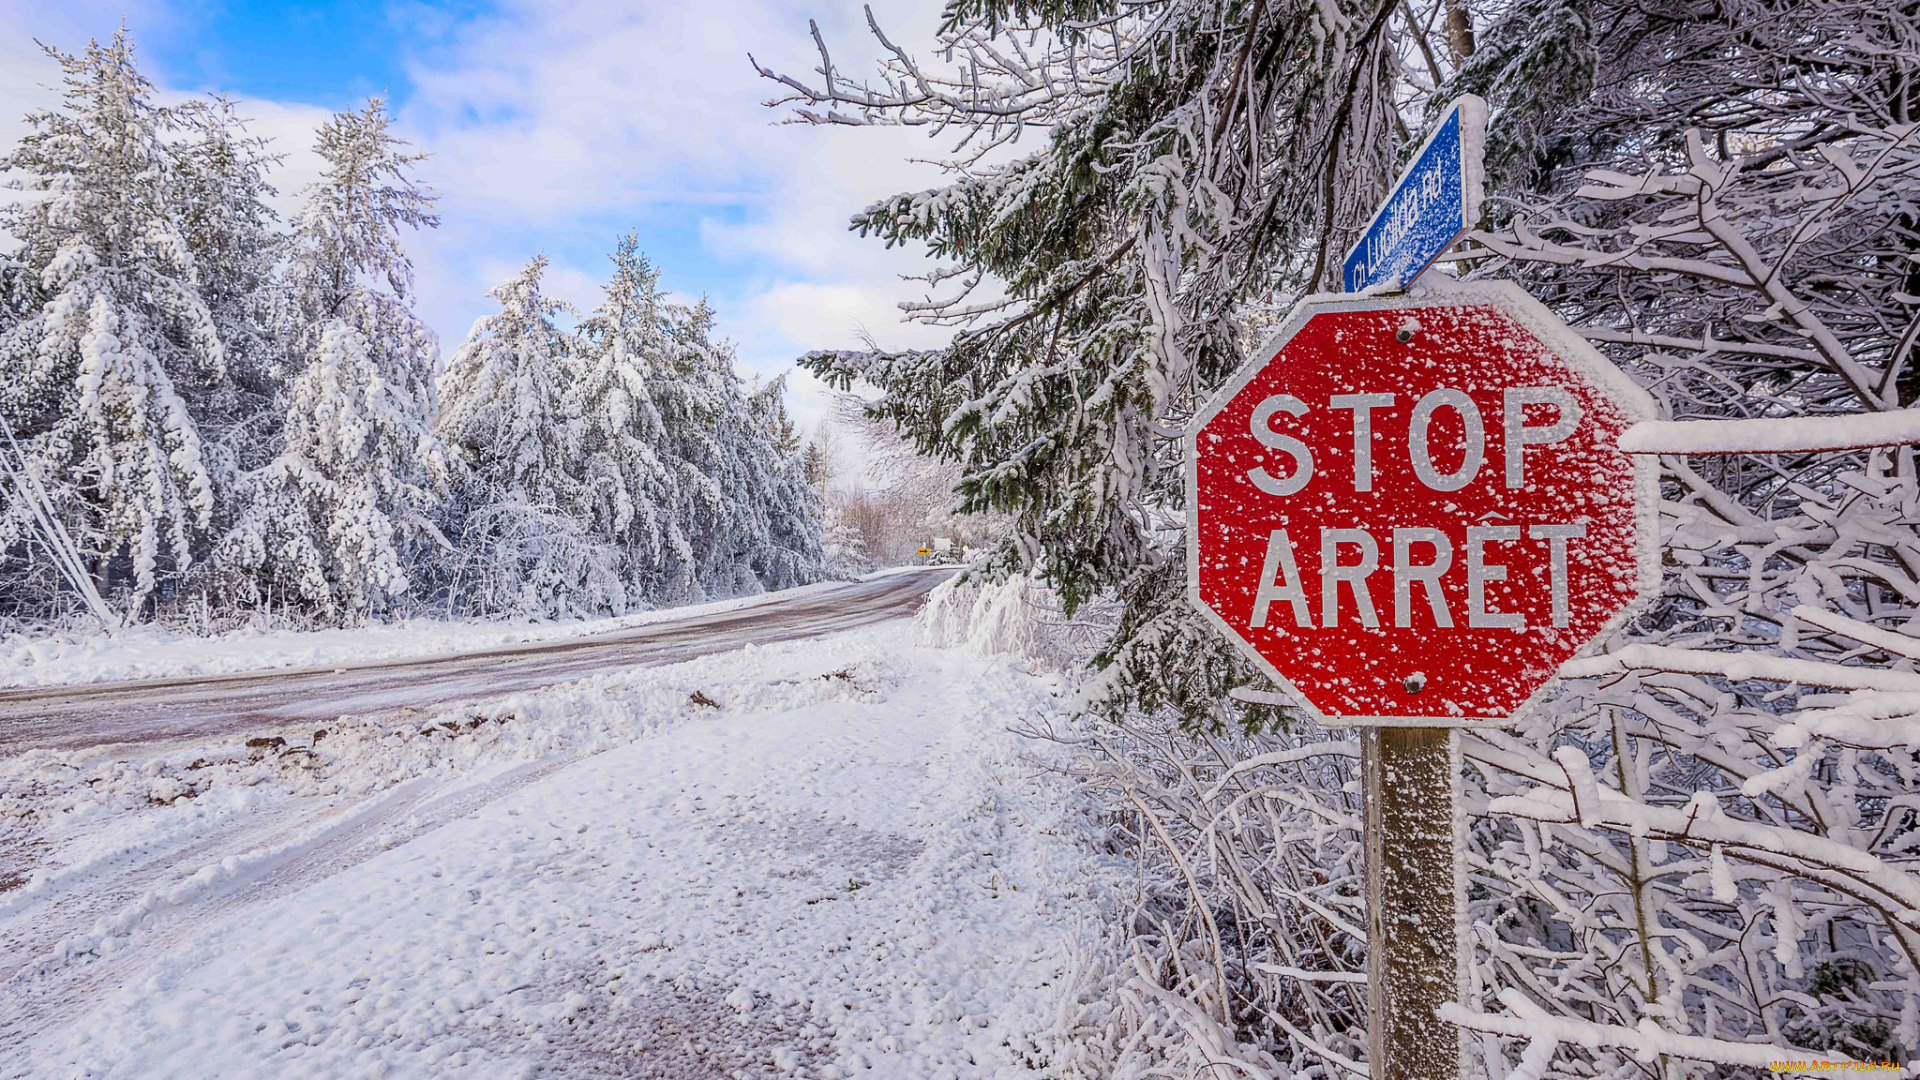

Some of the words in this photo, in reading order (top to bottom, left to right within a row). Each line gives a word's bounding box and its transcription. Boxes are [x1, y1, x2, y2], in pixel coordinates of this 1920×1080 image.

[1353, 260, 1366, 292] Ch
[1367, 186, 1419, 277] Lucilda
[1422, 156, 1442, 211] Rd
[1246, 386, 1580, 497] STOP
[1249, 510, 1587, 629] ARRÊT
